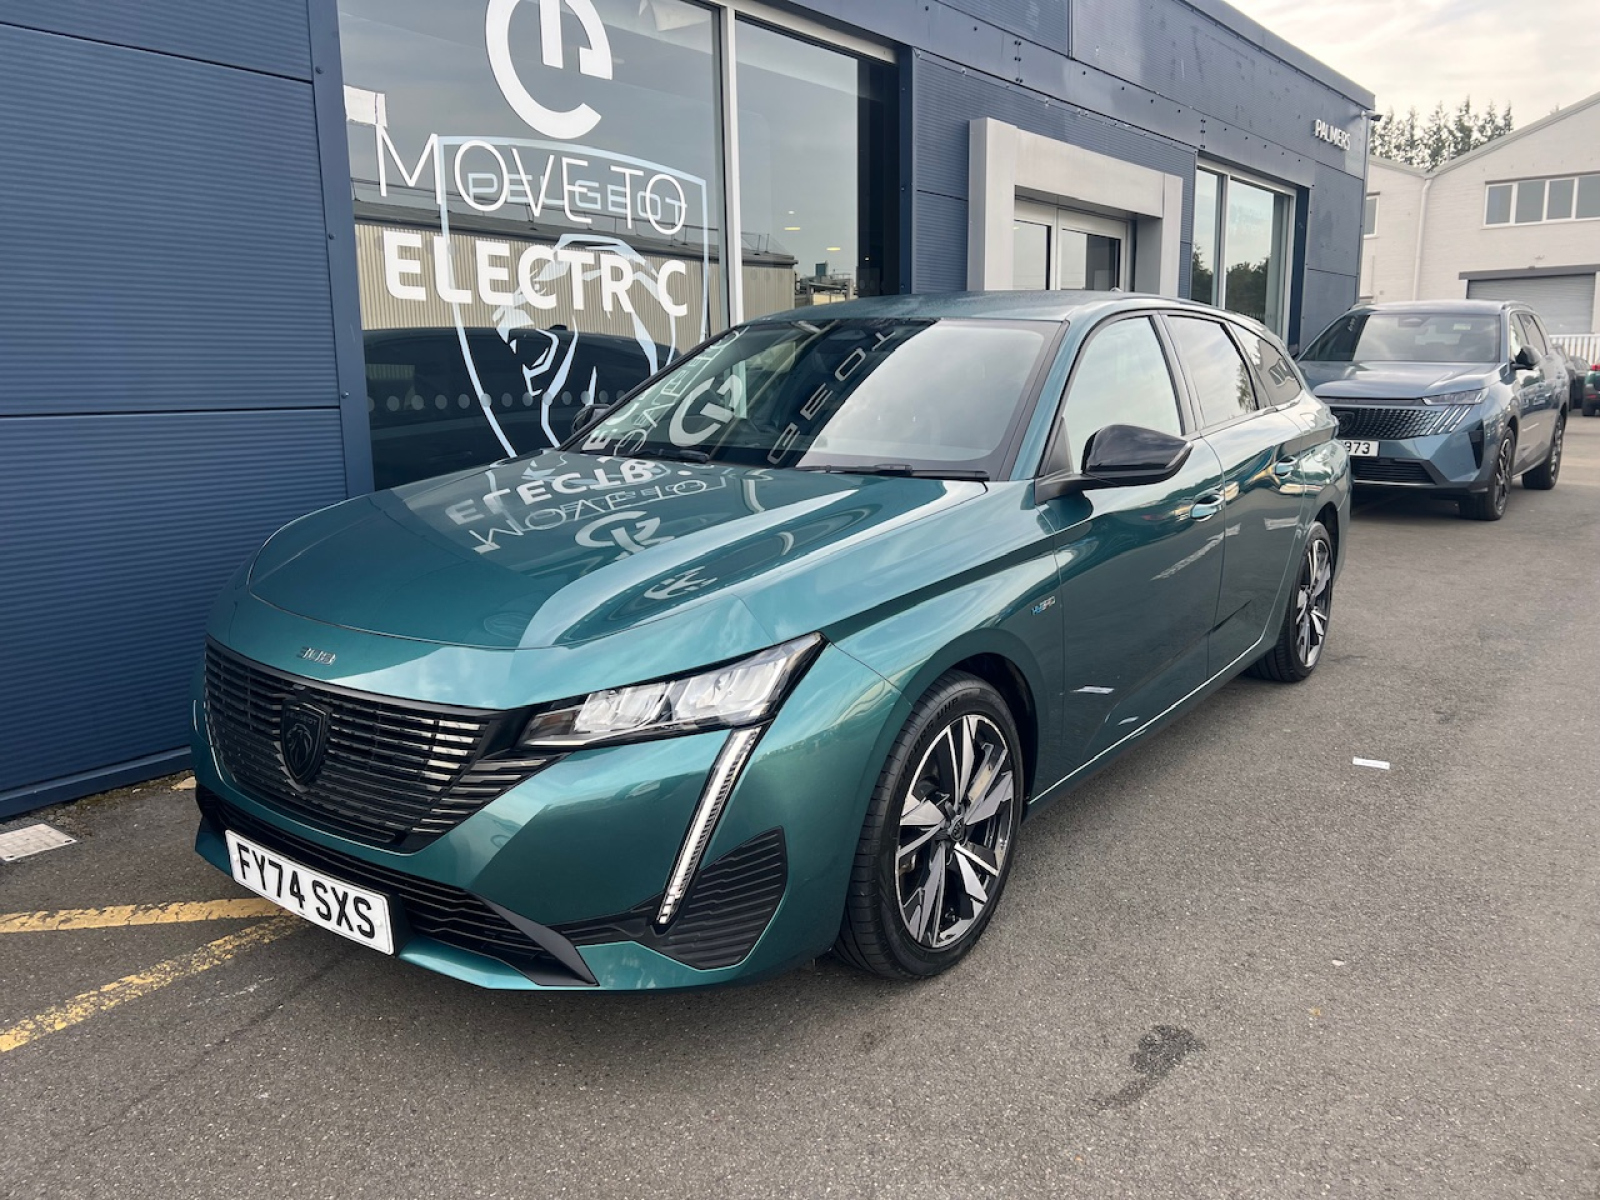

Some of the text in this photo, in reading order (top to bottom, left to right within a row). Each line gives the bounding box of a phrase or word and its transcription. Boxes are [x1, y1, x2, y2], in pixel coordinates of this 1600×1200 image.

[374, 124, 687, 236] MOVE TO
[1314, 118, 1351, 151] PALMERS
[236, 842, 377, 940] FY74 SXS
